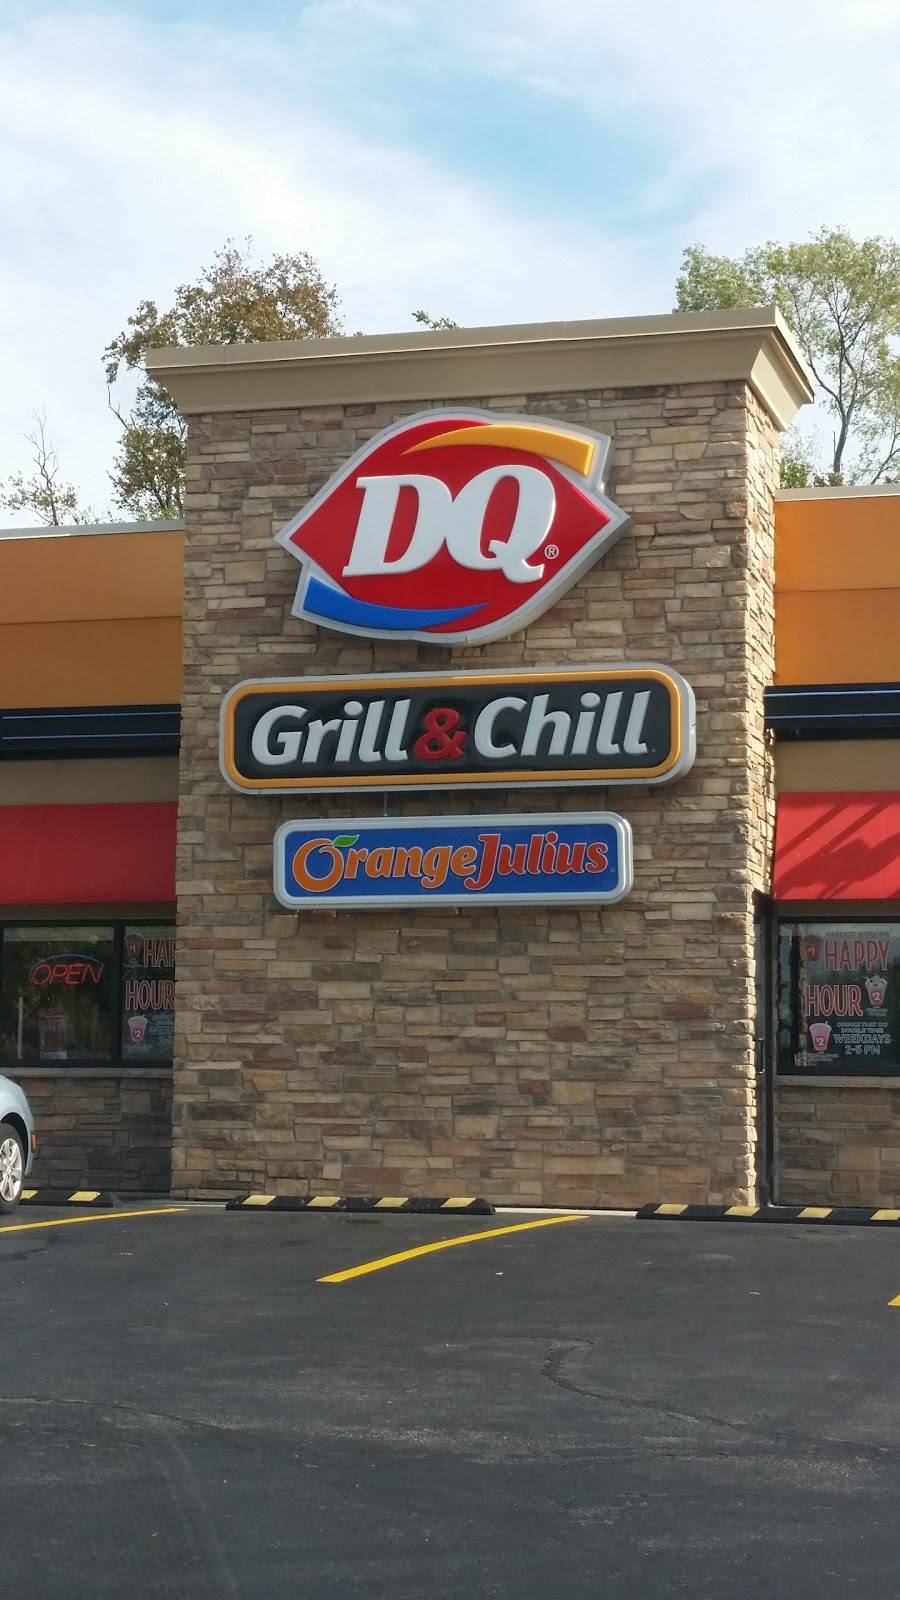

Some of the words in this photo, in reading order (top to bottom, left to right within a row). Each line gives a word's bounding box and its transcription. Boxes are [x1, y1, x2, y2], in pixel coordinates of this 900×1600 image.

[342, 464, 557, 584] DQ
[251, 699, 411, 766] Grill
[413, 707, 469, 762] &
[474, 689, 652, 759] Chill
[824, 940, 890, 971] HAPPY
[30, 963, 104, 986] OPEN
[804, 985, 863, 1016] HOUR
[833, 1034, 891, 1044] WEEKDAYS
[864, 1045, 881, 1055] PM
